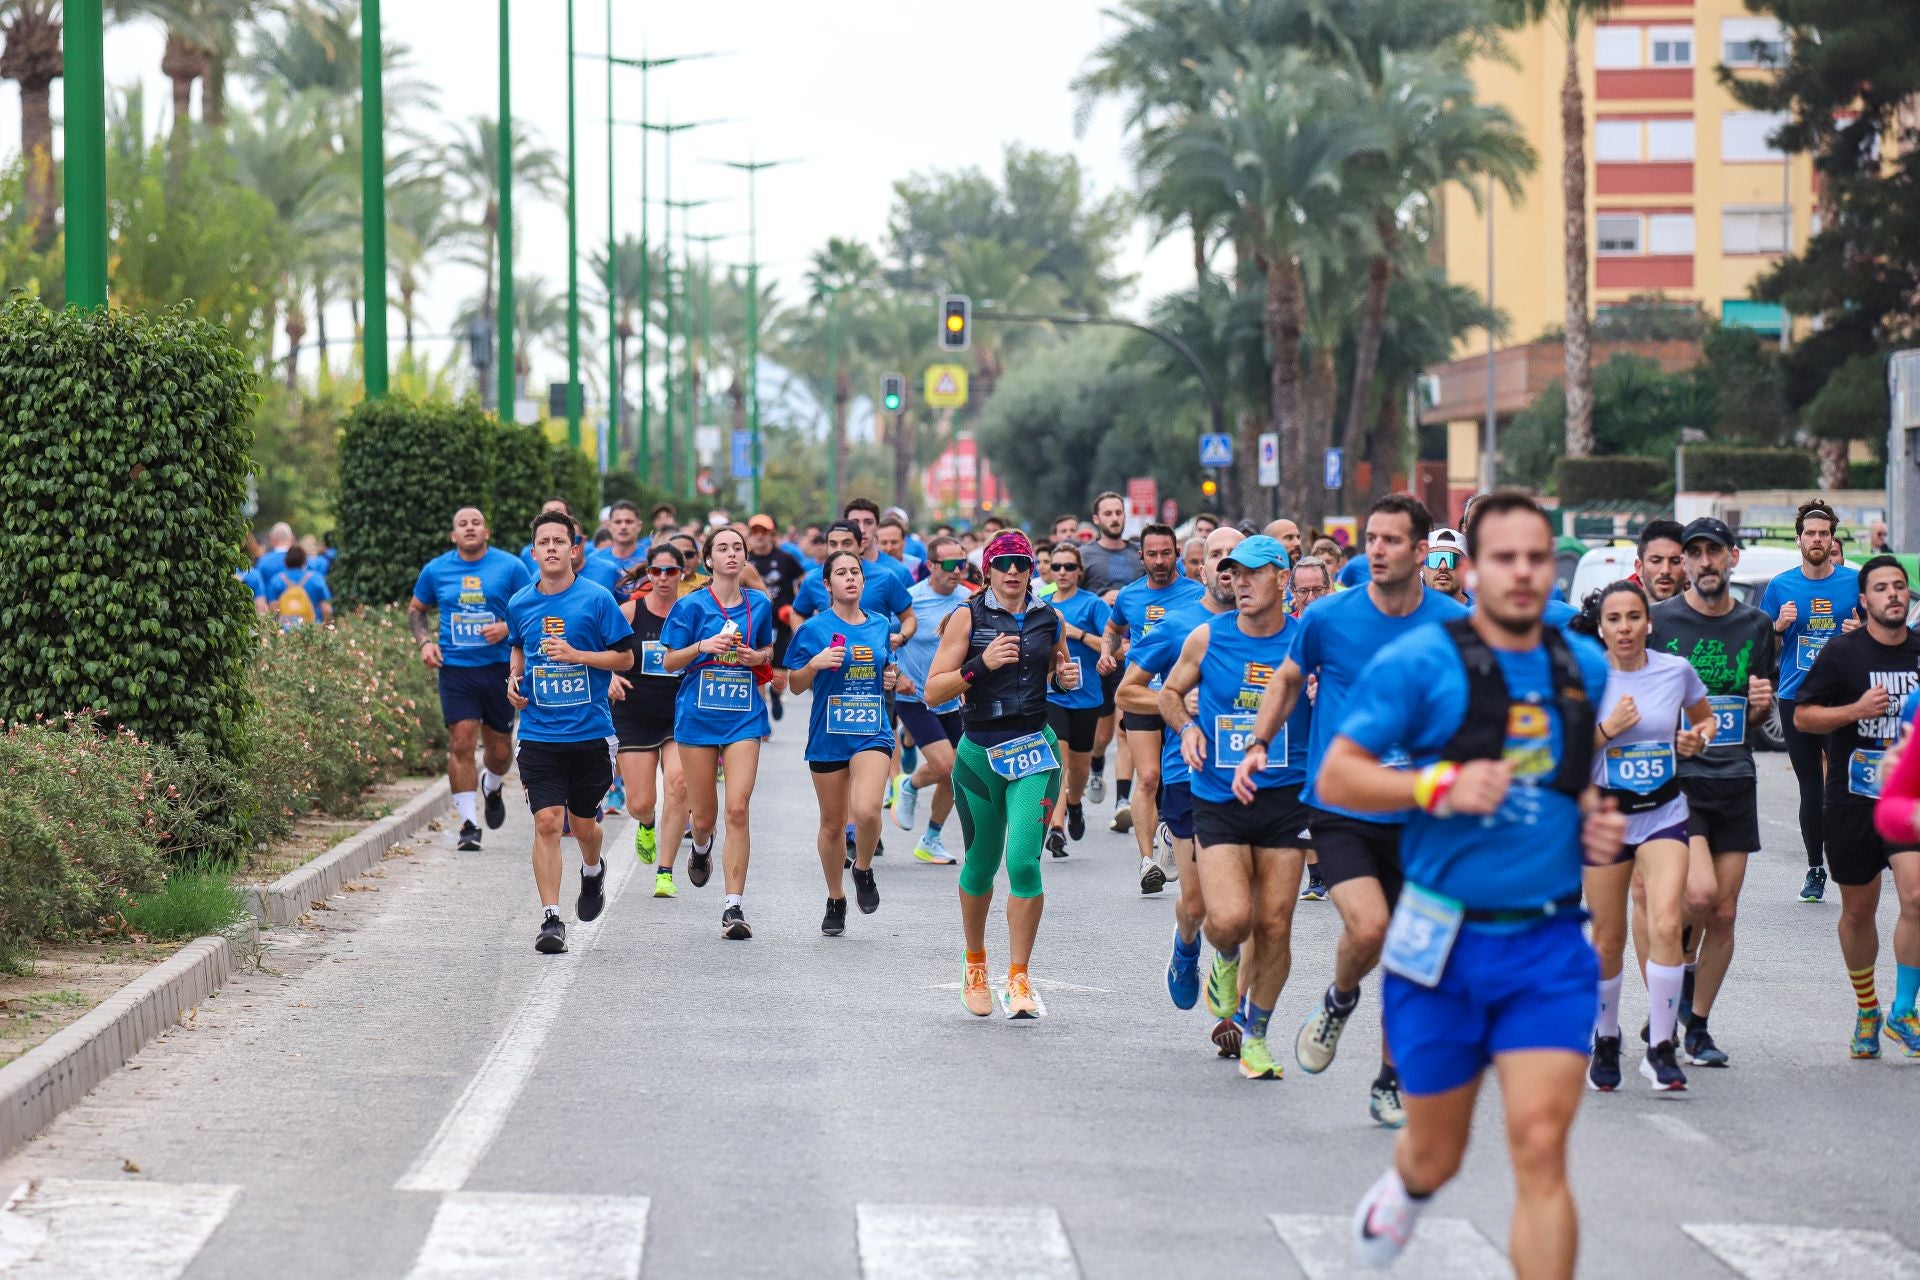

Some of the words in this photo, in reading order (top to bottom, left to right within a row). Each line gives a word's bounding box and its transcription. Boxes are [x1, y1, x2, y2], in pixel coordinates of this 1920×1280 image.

[456, 624, 489, 635] 118
[653, 653, 663, 664] 3
[1687, 655, 1727, 668] UERTA
[540, 678, 585, 694] 1182
[706, 683, 748, 698] 1175
[1869, 671, 1918, 695] UNITS
[833, 708, 877, 723] 1223
[1003, 749, 1042, 775] 780
[1620, 759, 1664, 779] 035
[1862, 766, 1876, 783] 3
